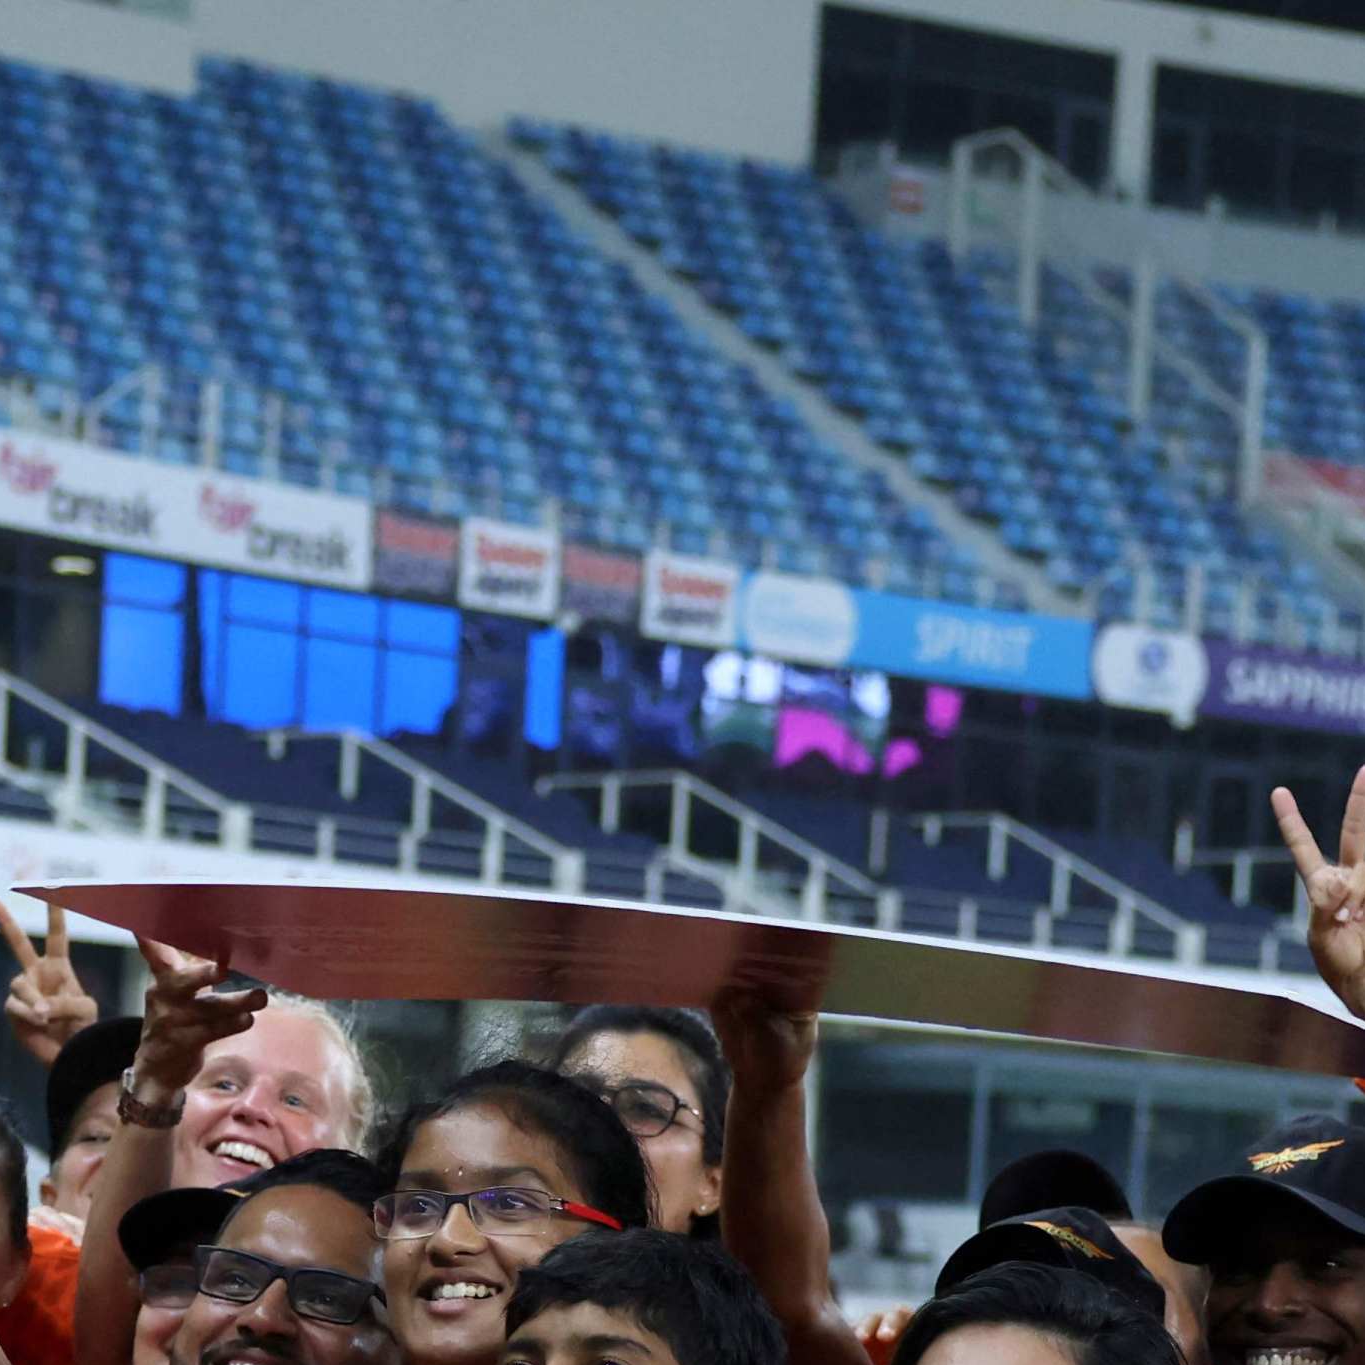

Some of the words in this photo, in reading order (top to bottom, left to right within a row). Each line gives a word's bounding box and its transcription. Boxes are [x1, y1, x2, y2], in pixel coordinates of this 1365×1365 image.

[48, 485, 159, 541] break
[248, 523, 352, 572] break
[915, 612, 1032, 670] SPIRIT
